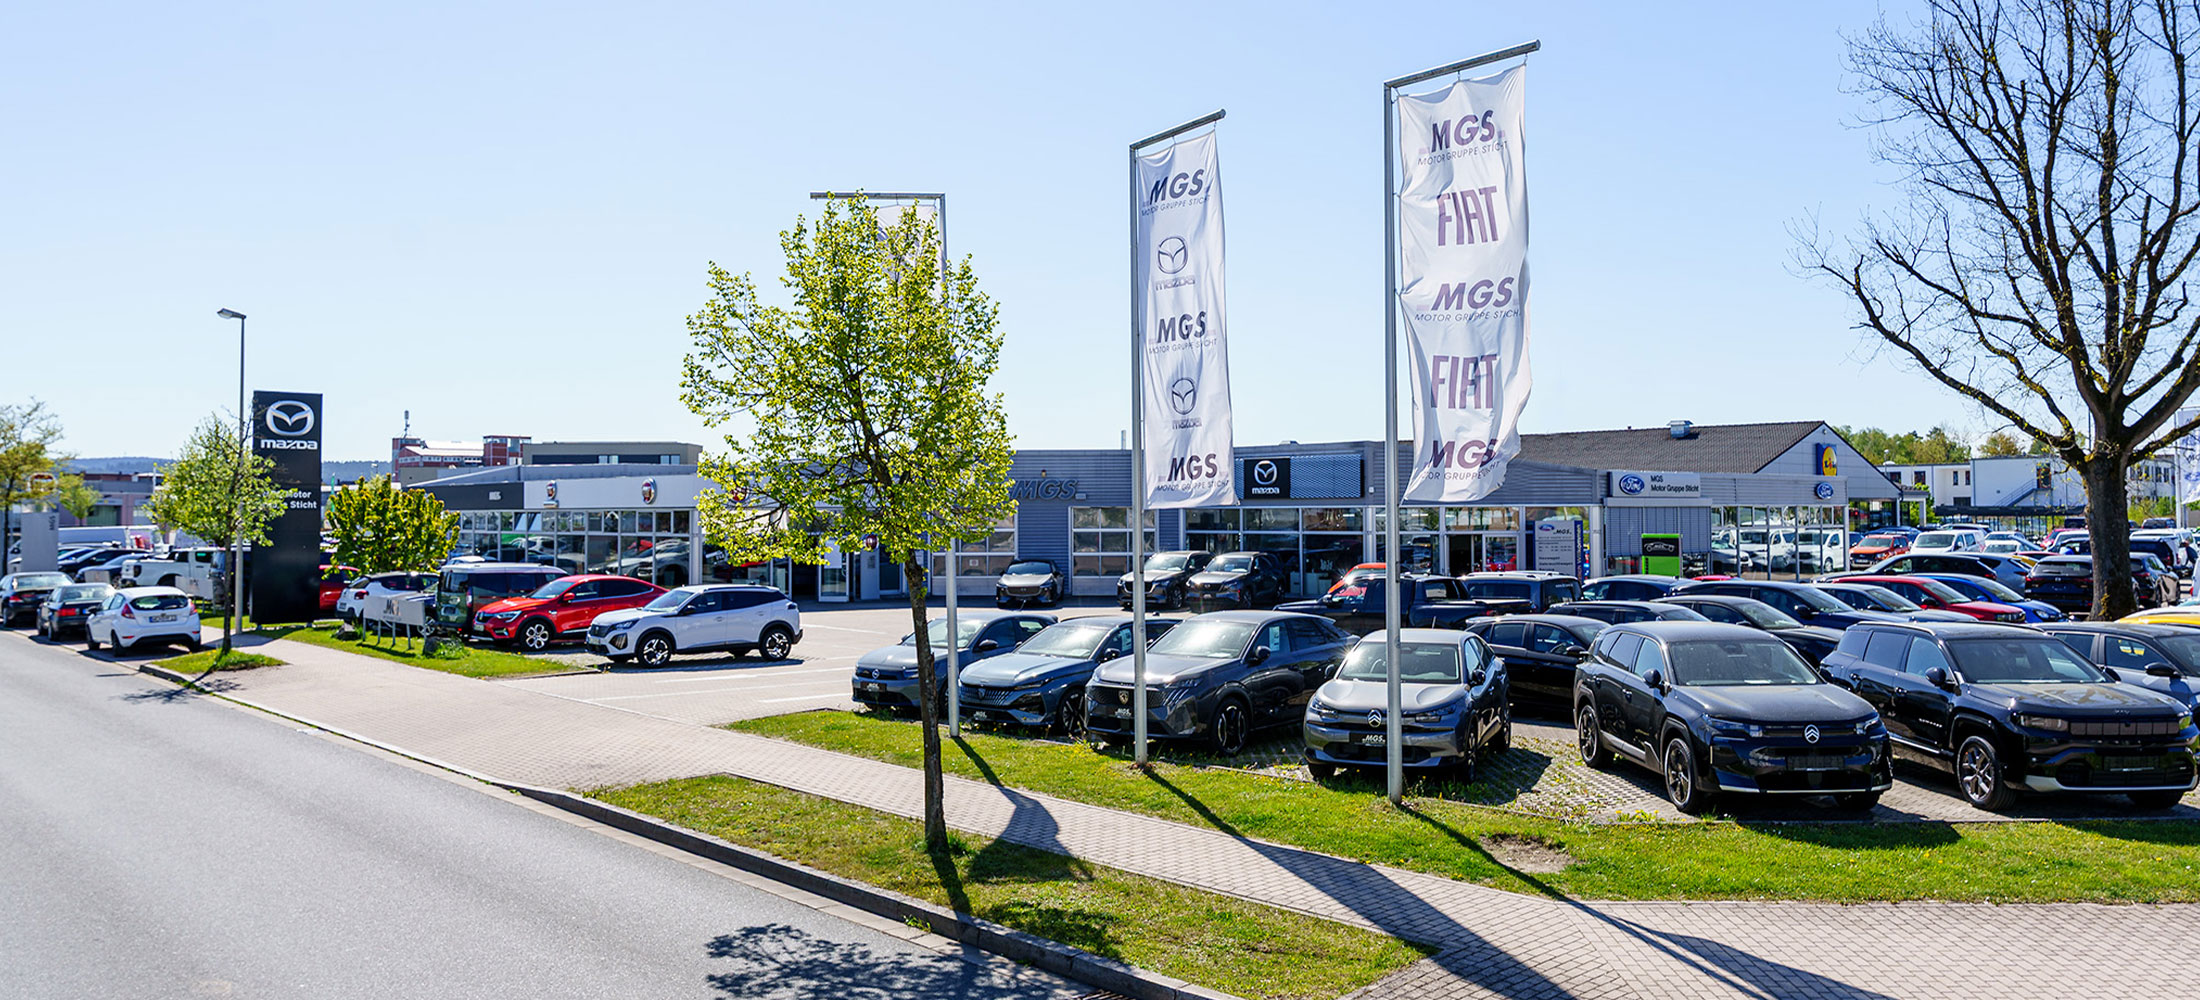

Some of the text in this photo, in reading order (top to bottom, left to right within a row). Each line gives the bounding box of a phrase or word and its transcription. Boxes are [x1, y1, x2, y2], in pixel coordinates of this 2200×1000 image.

[1436, 185, 1499, 246] FIAT
[1431, 276, 1515, 311] MGS
[1415, 313, 1452, 322] MOTOR
[1431, 353, 1498, 409] FIAT
[260, 439, 318, 450] mazda
[1167, 453, 1218, 482] MGS
[1650, 475, 1664, 483] MGS
[1650, 484, 1699, 493] Motor Gruppe Sticht
[290, 501, 317, 509] Sticht
